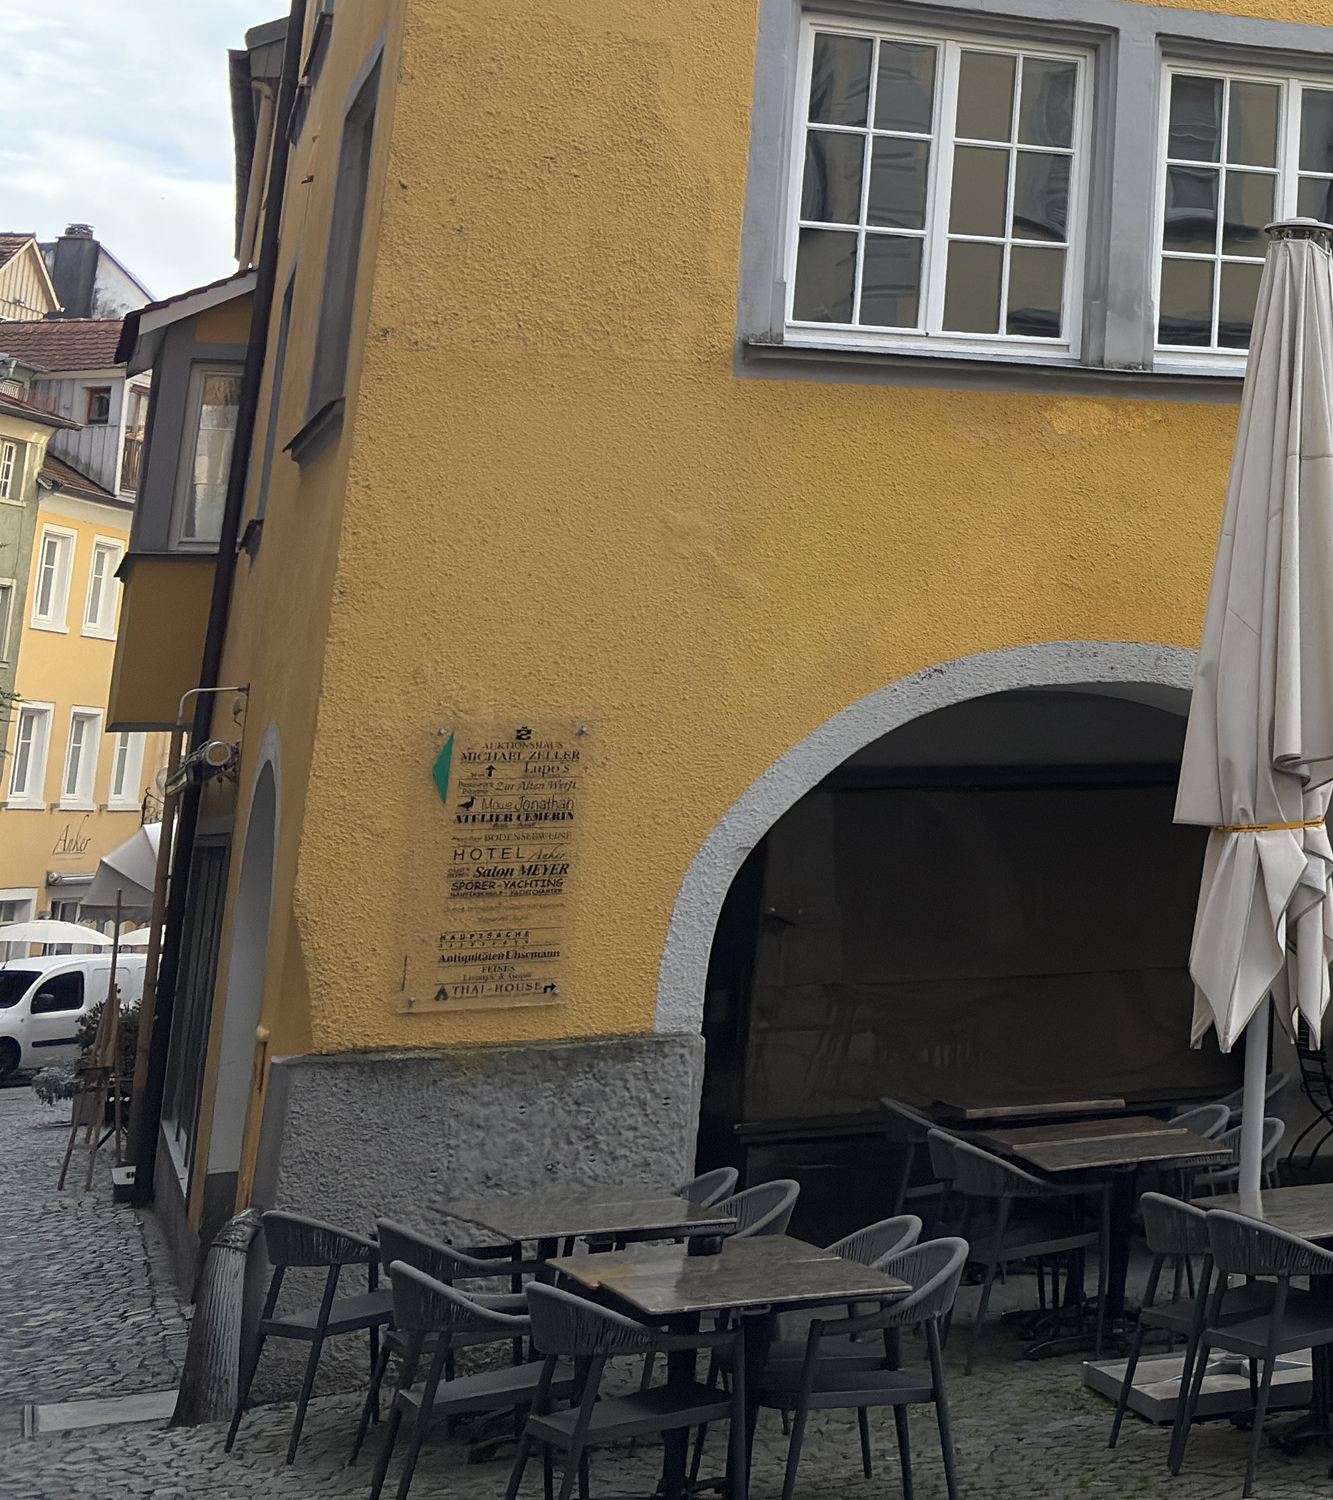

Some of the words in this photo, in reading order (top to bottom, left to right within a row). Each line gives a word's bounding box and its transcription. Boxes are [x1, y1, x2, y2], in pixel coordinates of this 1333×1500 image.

[461, 751, 525, 762] MICHAEL
[528, 750, 580, 761] ZELLER
[514, 795, 575, 811] Jonathan
[52, 814, 91, 855] Anker
[453, 847, 525, 861] HOTEL
[473, 865, 515, 878] Salon
[517, 863, 570, 876] MEYER
